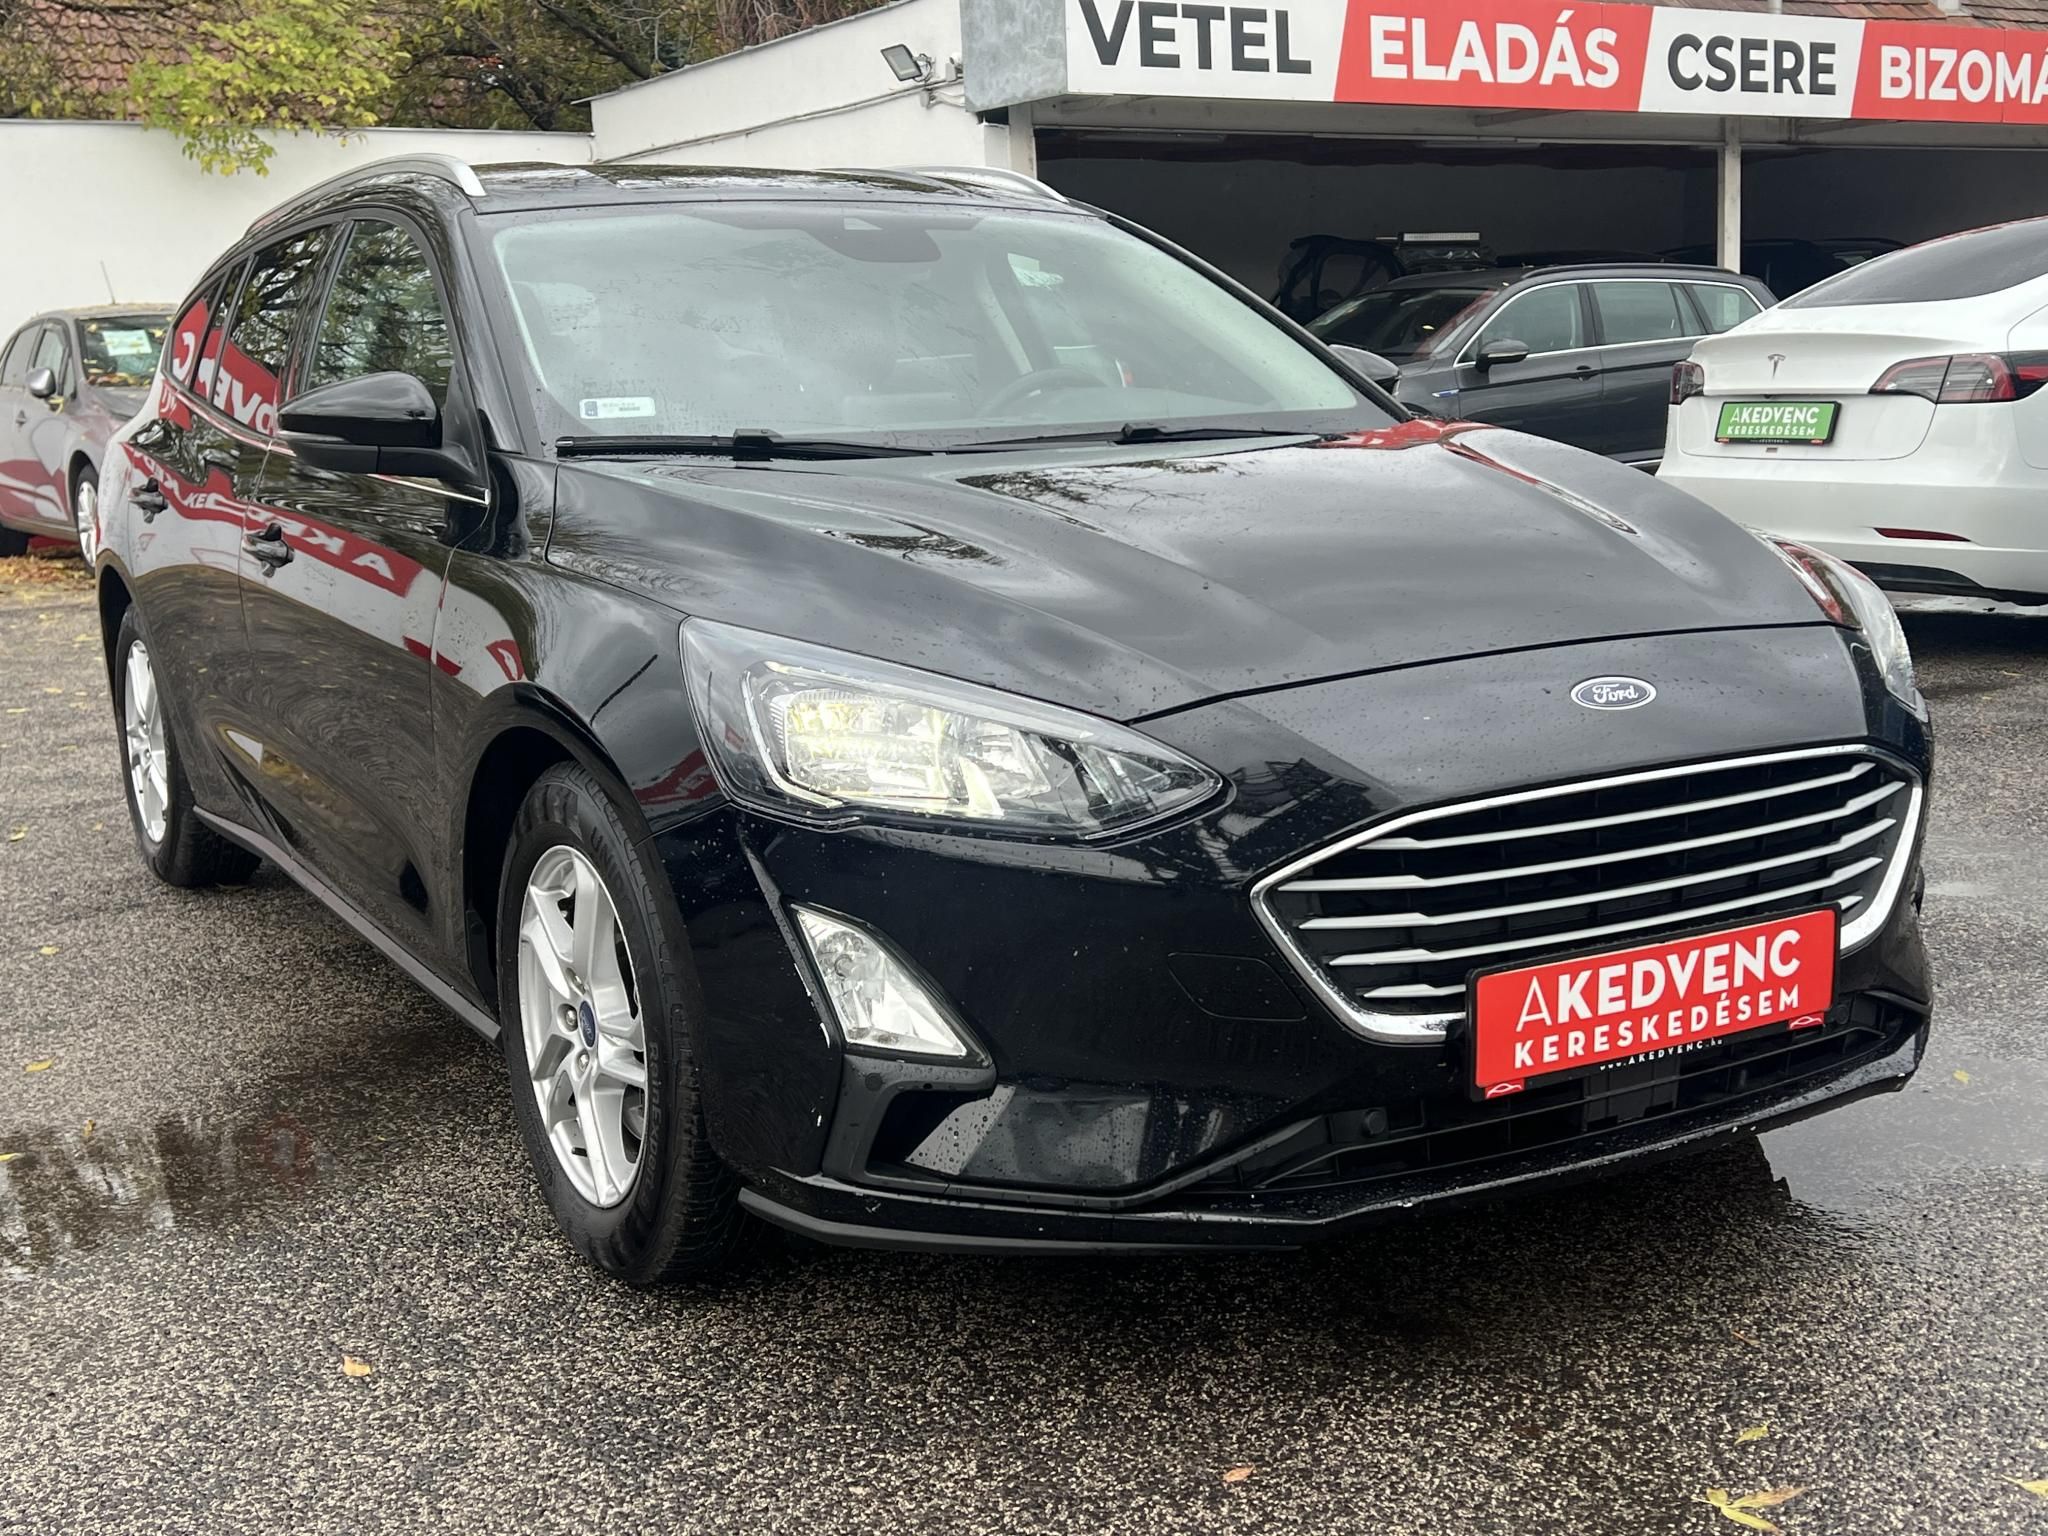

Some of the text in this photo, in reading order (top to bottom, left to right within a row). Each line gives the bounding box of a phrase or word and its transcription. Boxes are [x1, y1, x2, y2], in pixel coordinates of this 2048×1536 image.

[1369, 9, 1620, 89] ELADÁS
[1666, 32, 1837, 96] CSERE
[1727, 424, 1816, 436] KERESKEDÉSEM
[1730, 406, 1820, 424] AKEDVENC
[1591, 683, 1639, 704] Ford
[1515, 928, 1802, 1033] AKEDVENC
[1513, 983, 1801, 1070] KERESKEDÉSEM
